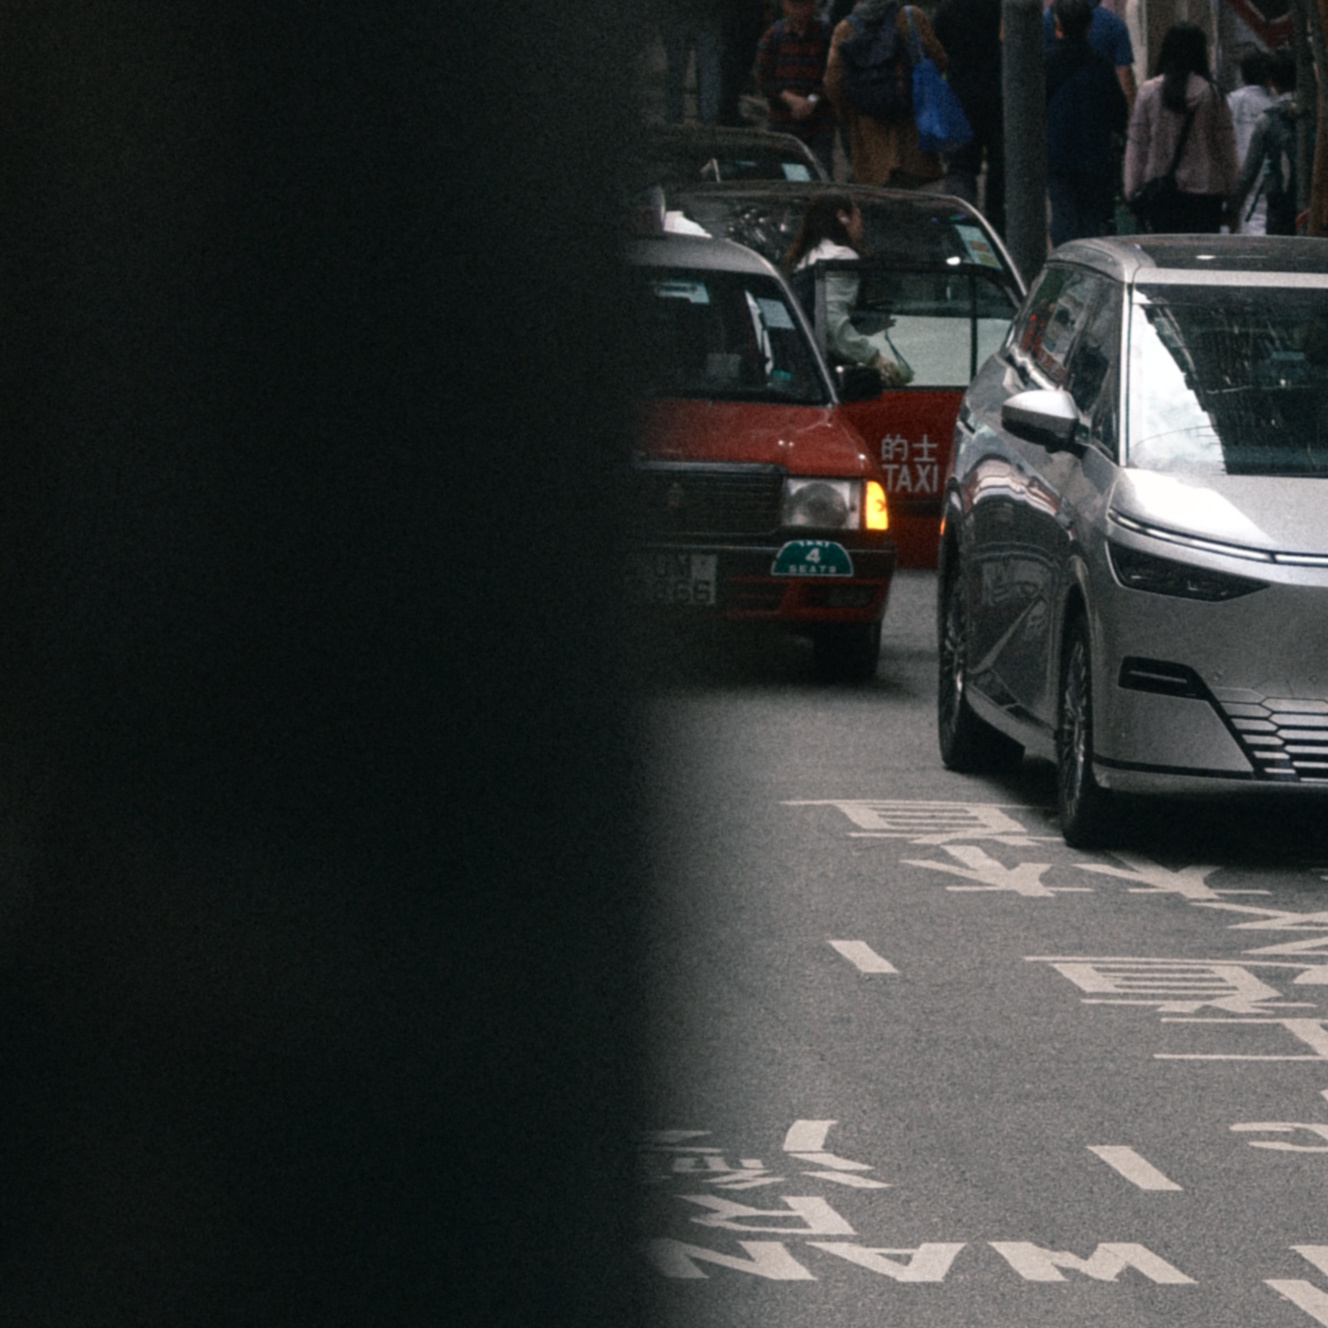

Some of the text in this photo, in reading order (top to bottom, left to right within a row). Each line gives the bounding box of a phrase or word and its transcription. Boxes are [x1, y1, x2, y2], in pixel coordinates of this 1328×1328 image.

[881, 433, 939, 463] 的士
[881, 463, 939, 494] TAXI
[804, 546, 821, 563] 4
[787, 563, 837, 574] SEATS
